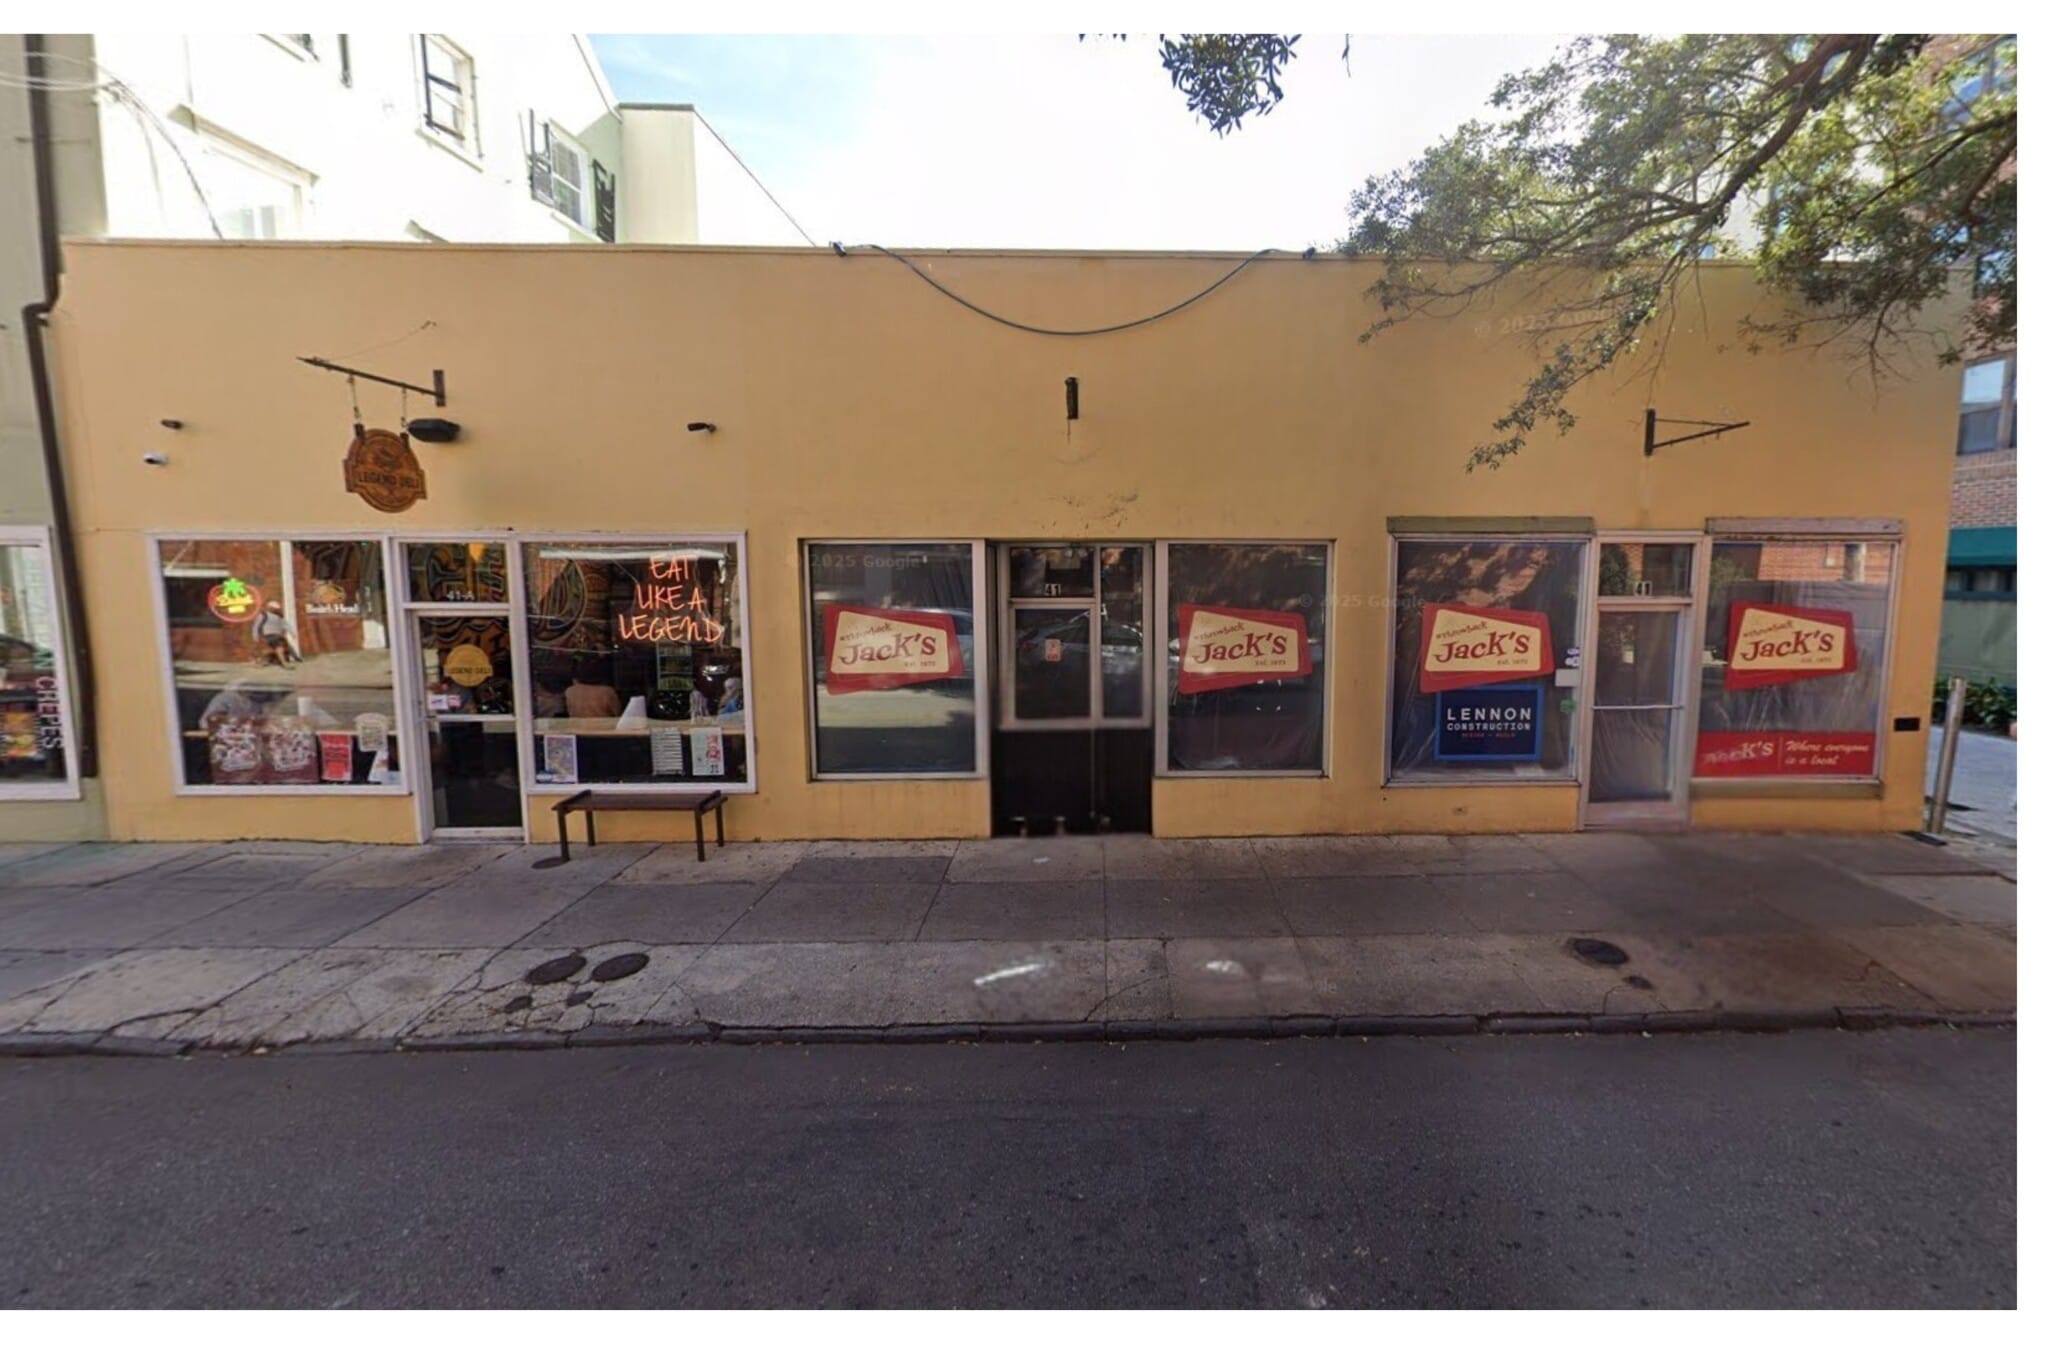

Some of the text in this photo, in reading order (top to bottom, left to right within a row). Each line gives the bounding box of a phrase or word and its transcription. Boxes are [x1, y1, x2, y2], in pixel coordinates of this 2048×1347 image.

[649, 553, 698, 582] EAT
[636, 583, 708, 613] LIKE A
[1045, 584, 1061, 596] 41
[618, 613, 725, 644] LEGEND
[838, 631, 938, 665] Jack's
[1192, 632, 1289, 664] Jack's
[1433, 630, 1531, 663] Jack's
[1740, 629, 1835, 662] Jack's
[36, 676, 65, 749] CREPES
[1446, 722, 1531, 731] CONSTRUCTION
[1447, 707, 1531, 720] LENNON
[1786, 740, 1869, 754] Where everyone
